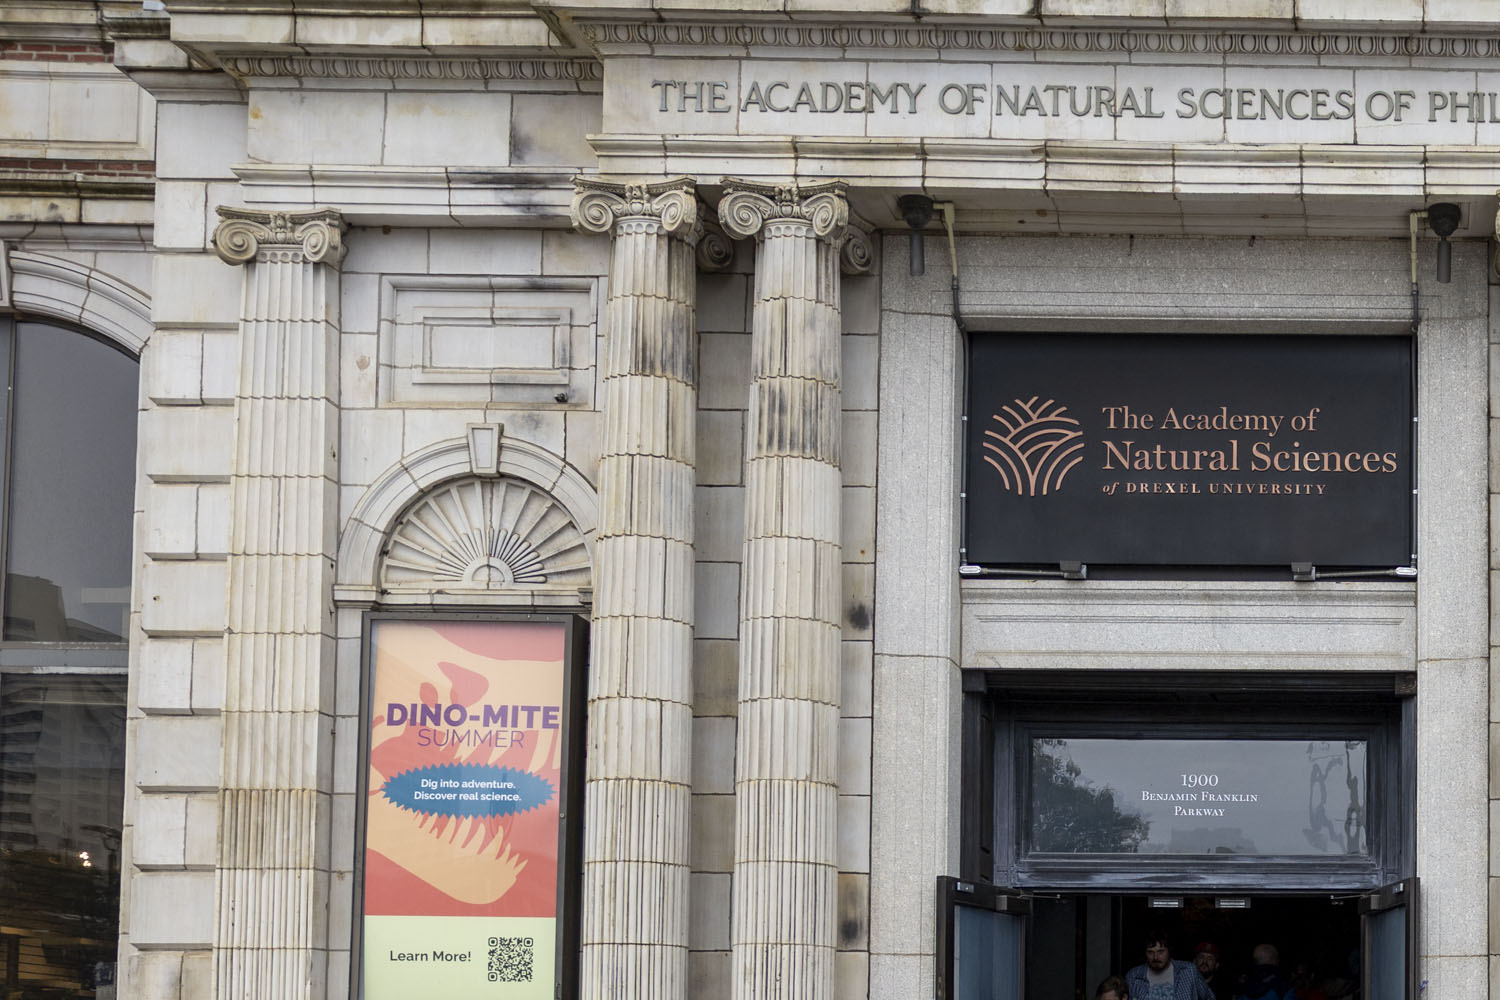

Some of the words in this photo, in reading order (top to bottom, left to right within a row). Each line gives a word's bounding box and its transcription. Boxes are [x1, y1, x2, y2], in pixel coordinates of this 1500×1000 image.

[652, 80, 732, 113] THE
[740, 81, 927, 115] ACADEMY
[938, 83, 989, 116] OF
[995, 84, 1167, 118] NATURAL
[1176, 87, 1356, 121] SCIENCES
[1365, 89, 1418, 122] OF
[1102, 406, 1155, 431] The
[1160, 407, 1285, 438] Academy
[1290, 408, 1322, 432] of
[1101, 440, 1241, 472] Natural
[1251, 440, 1398, 473] Sciences
[1102, 481, 1122, 496] of
[1126, 483, 1202, 494] DREXEL
[1209, 483, 1328, 495] UNIVERSITY
[386, 703, 560, 729] DINO-MITE
[417, 728, 526, 749] SUMMER
[421, 779, 438, 790] Dig
[439, 779, 460, 789] into
[461, 780, 516, 790] adventure.
[1181, 774, 1219, 788] 1900
[414, 791, 458, 802] Discover
[459, 791, 479, 801] real
[480, 791, 522, 803] science.
[389, 949, 428, 963] Learn
[432, 949, 472, 963] More!
